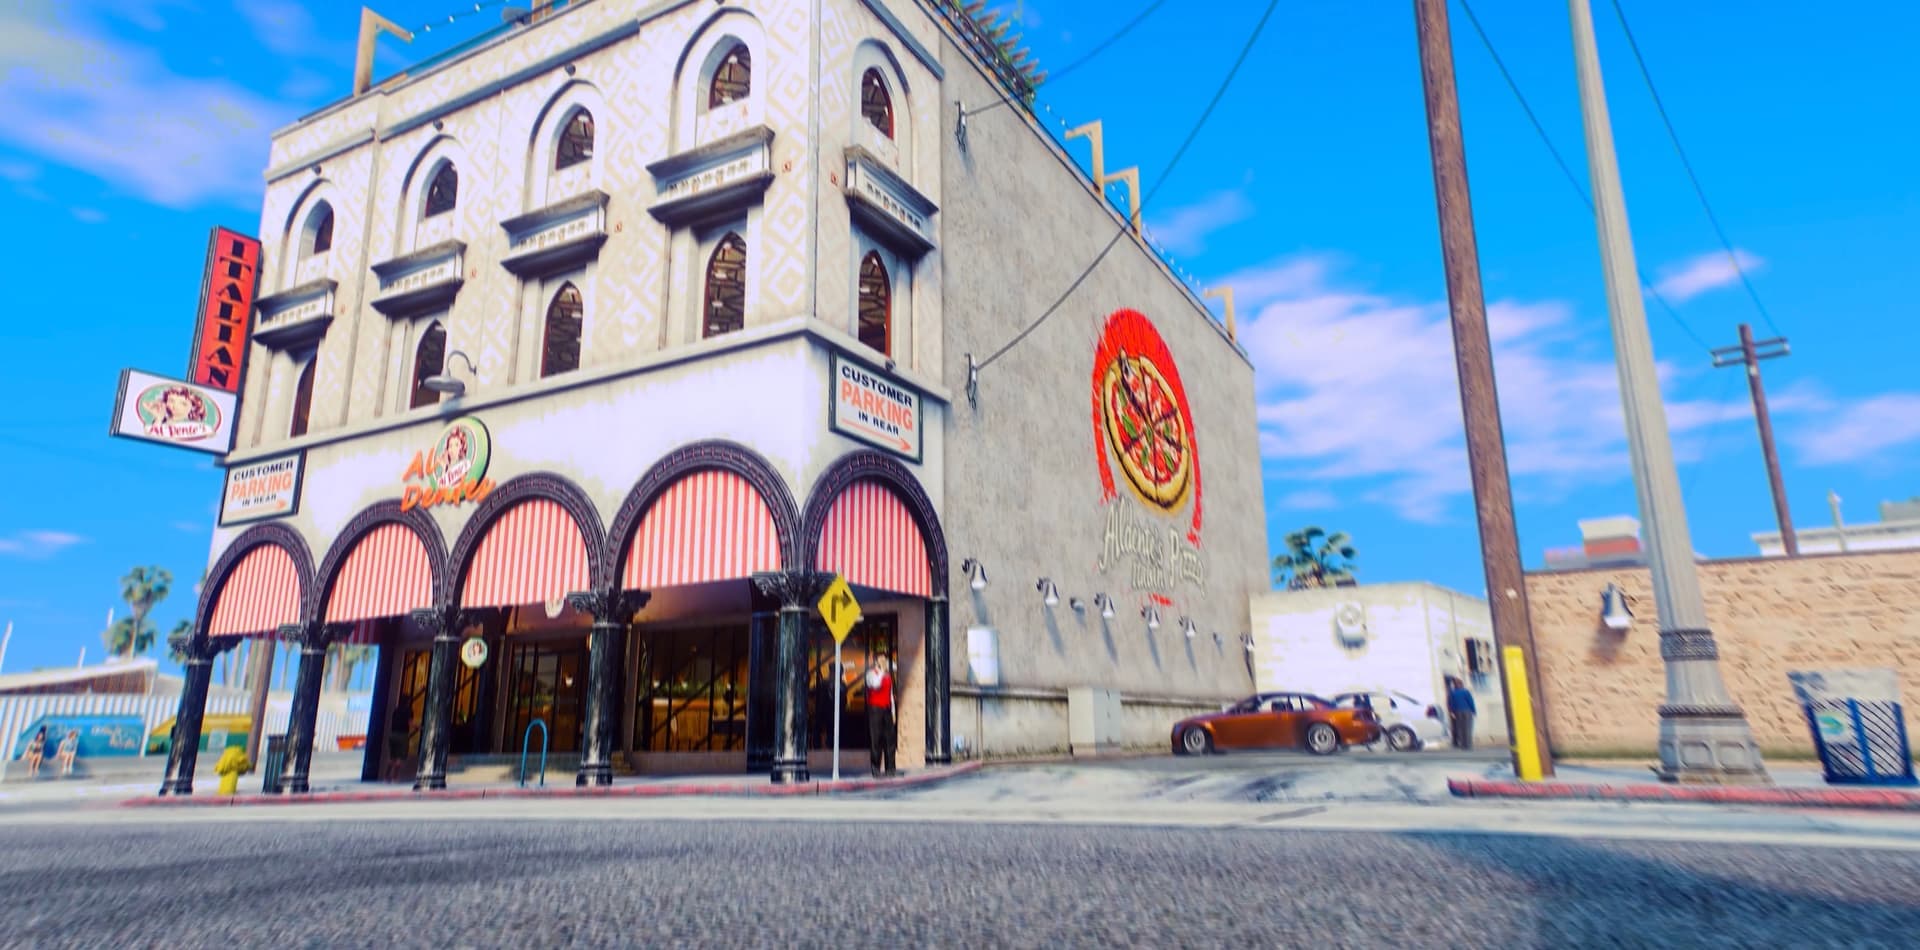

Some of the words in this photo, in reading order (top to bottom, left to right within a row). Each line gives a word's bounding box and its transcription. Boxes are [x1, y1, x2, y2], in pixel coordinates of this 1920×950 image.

[205, 240, 252, 387] ITALIAN
[841, 365, 912, 408] CUSTOMER
[841, 379, 913, 430] PARKING
[150, 425, 164, 436] Al
[858, 410, 869, 423] IN
[873, 418, 900, 436] REAR
[234, 459, 293, 481] CUSTOMER
[231, 471, 292, 502] PARKING
[242, 498, 250, 507] IN
